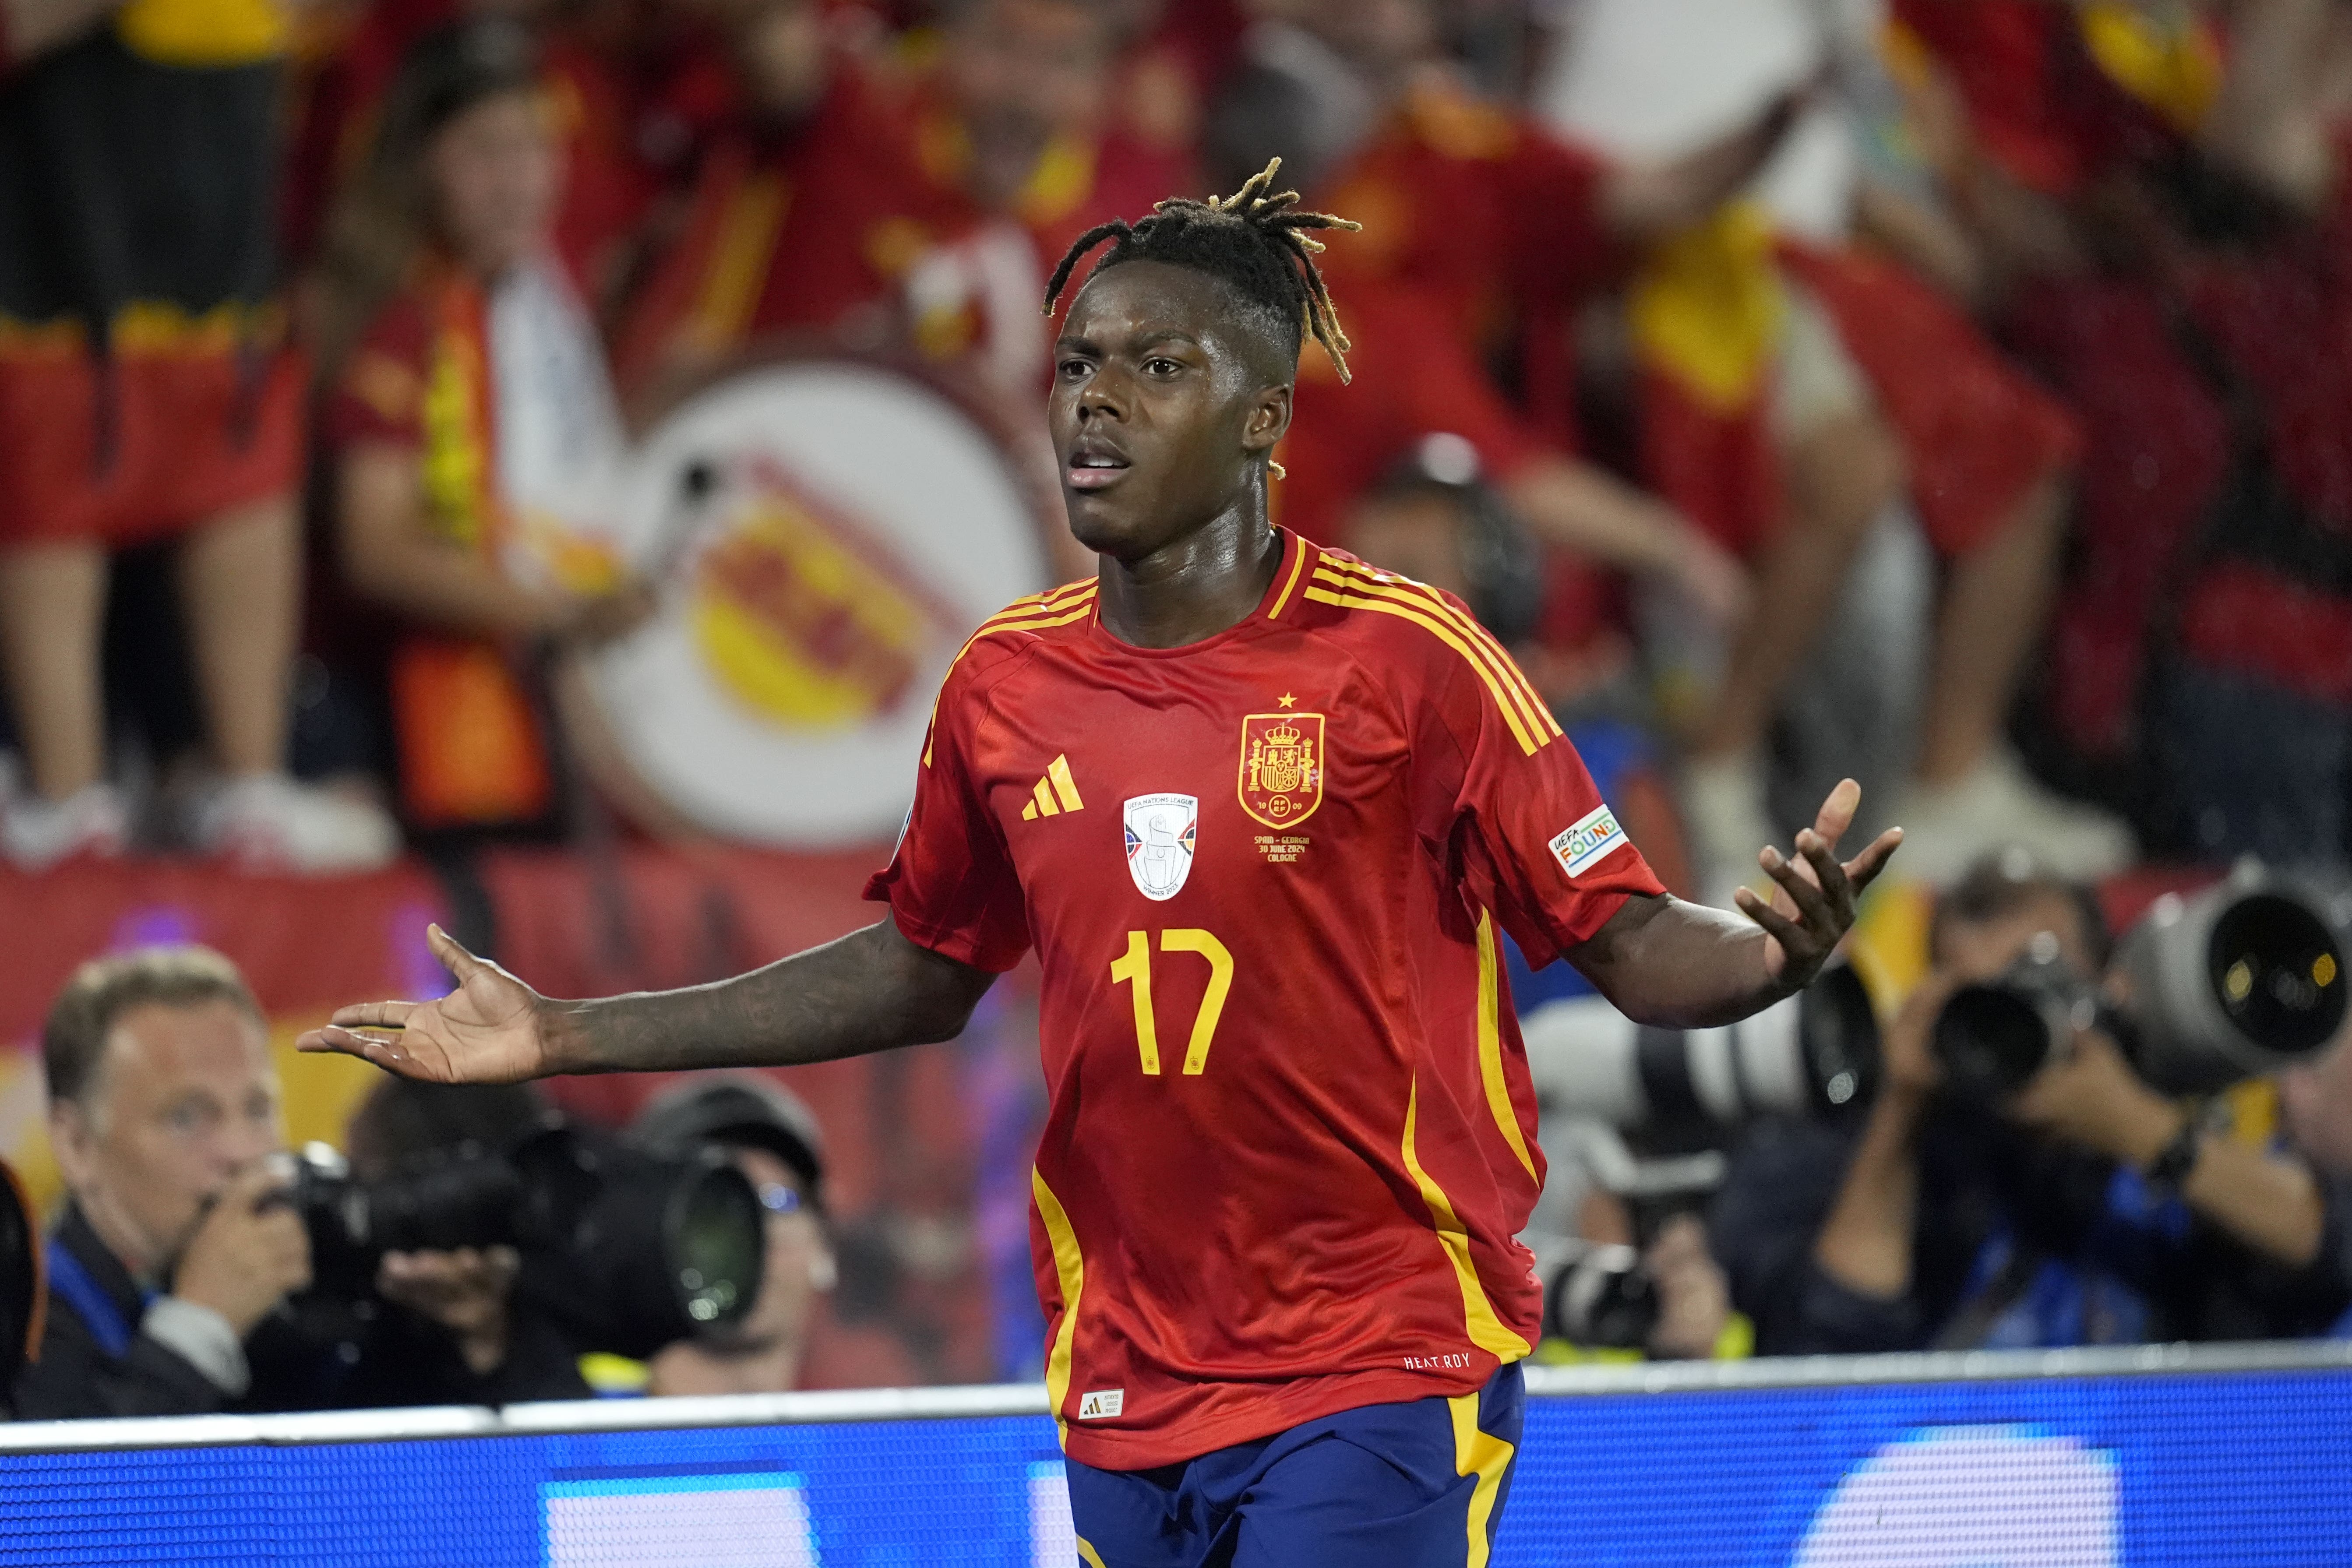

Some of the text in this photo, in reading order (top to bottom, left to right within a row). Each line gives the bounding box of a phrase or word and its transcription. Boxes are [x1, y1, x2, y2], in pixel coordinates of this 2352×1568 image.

[1171, 797, 1194, 806] LEAGUE
[1555, 829, 1579, 849] UEFA
[1287, 845, 1305, 853] 2024
[1144, 883, 1178, 896] WINNER 2023
[1110, 928, 1234, 1075] 17
[1403, 1353, 1469, 1370] HEAT.RDY
